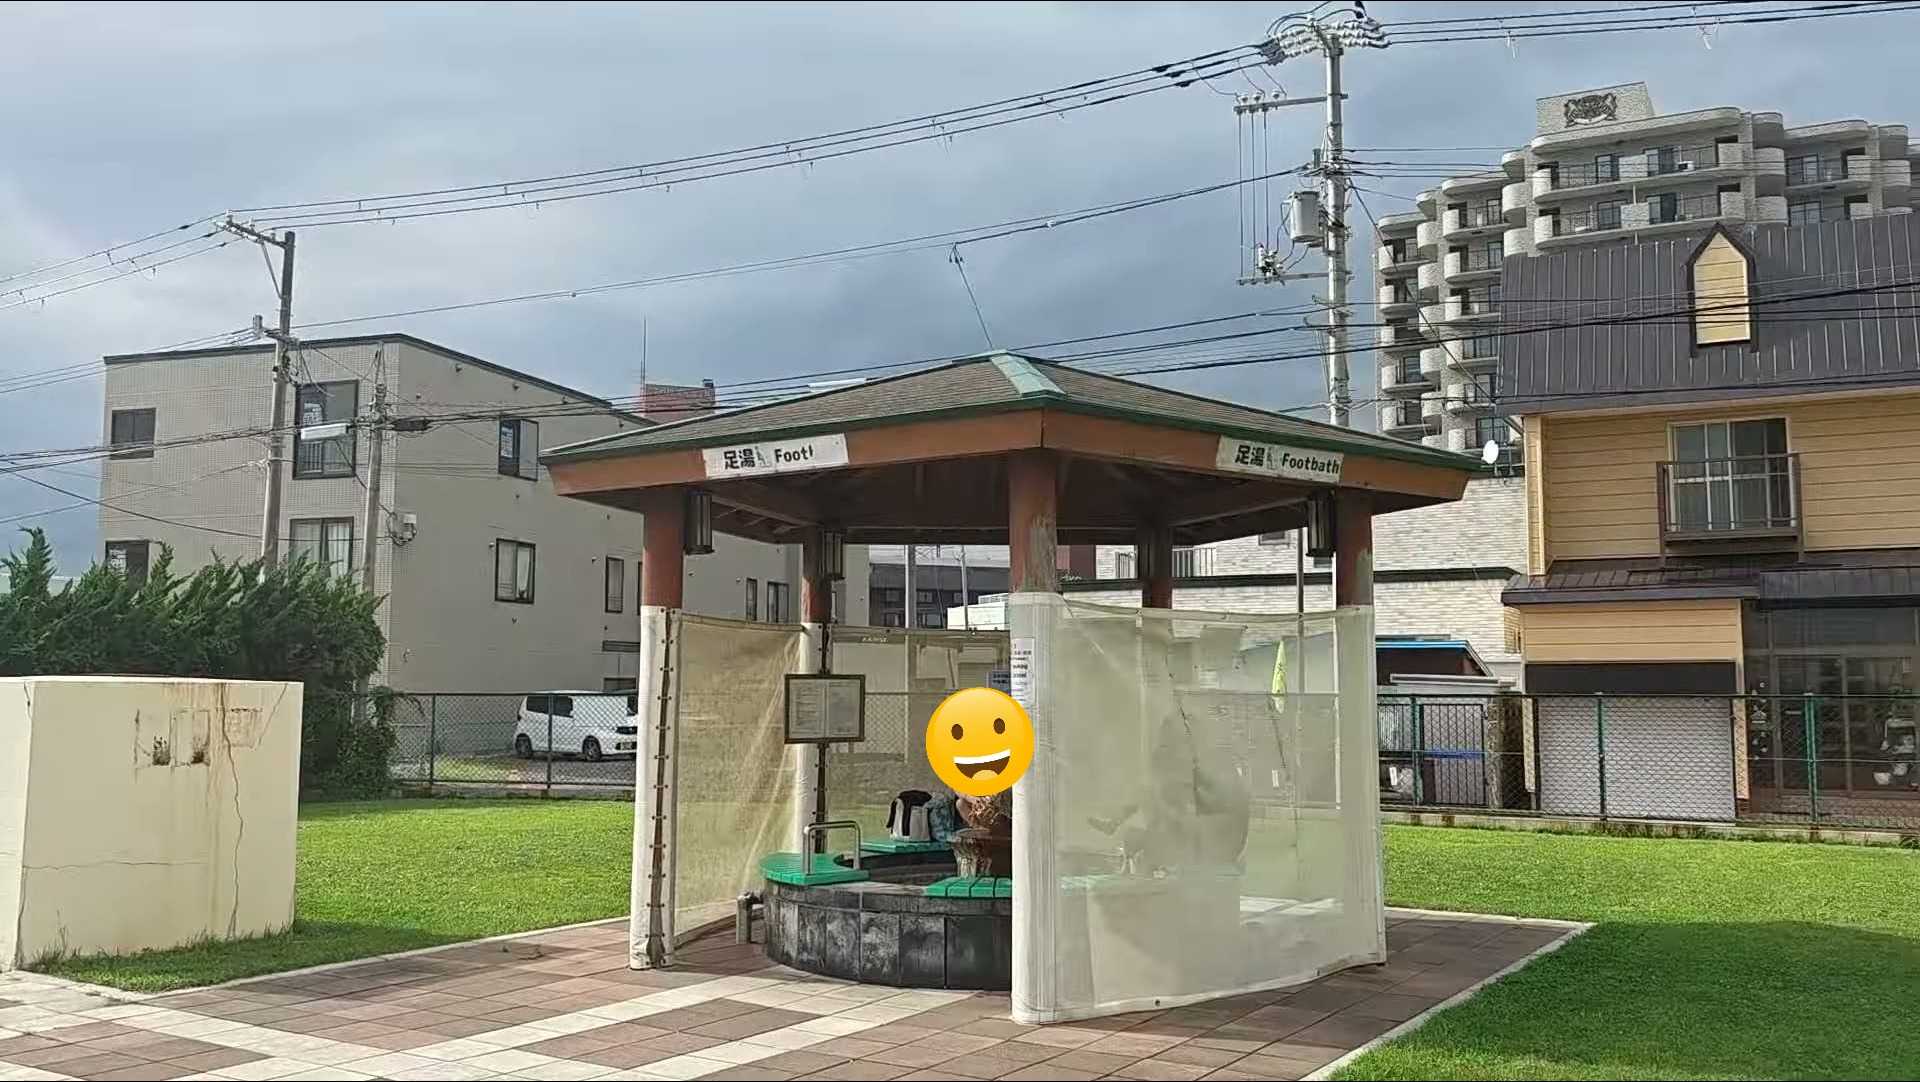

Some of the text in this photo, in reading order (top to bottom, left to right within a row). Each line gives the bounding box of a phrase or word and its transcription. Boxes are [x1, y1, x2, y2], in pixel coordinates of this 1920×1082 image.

[723, 448, 756, 470] 足湯
[1235, 445, 1340, 474] 足湯 Footbath
